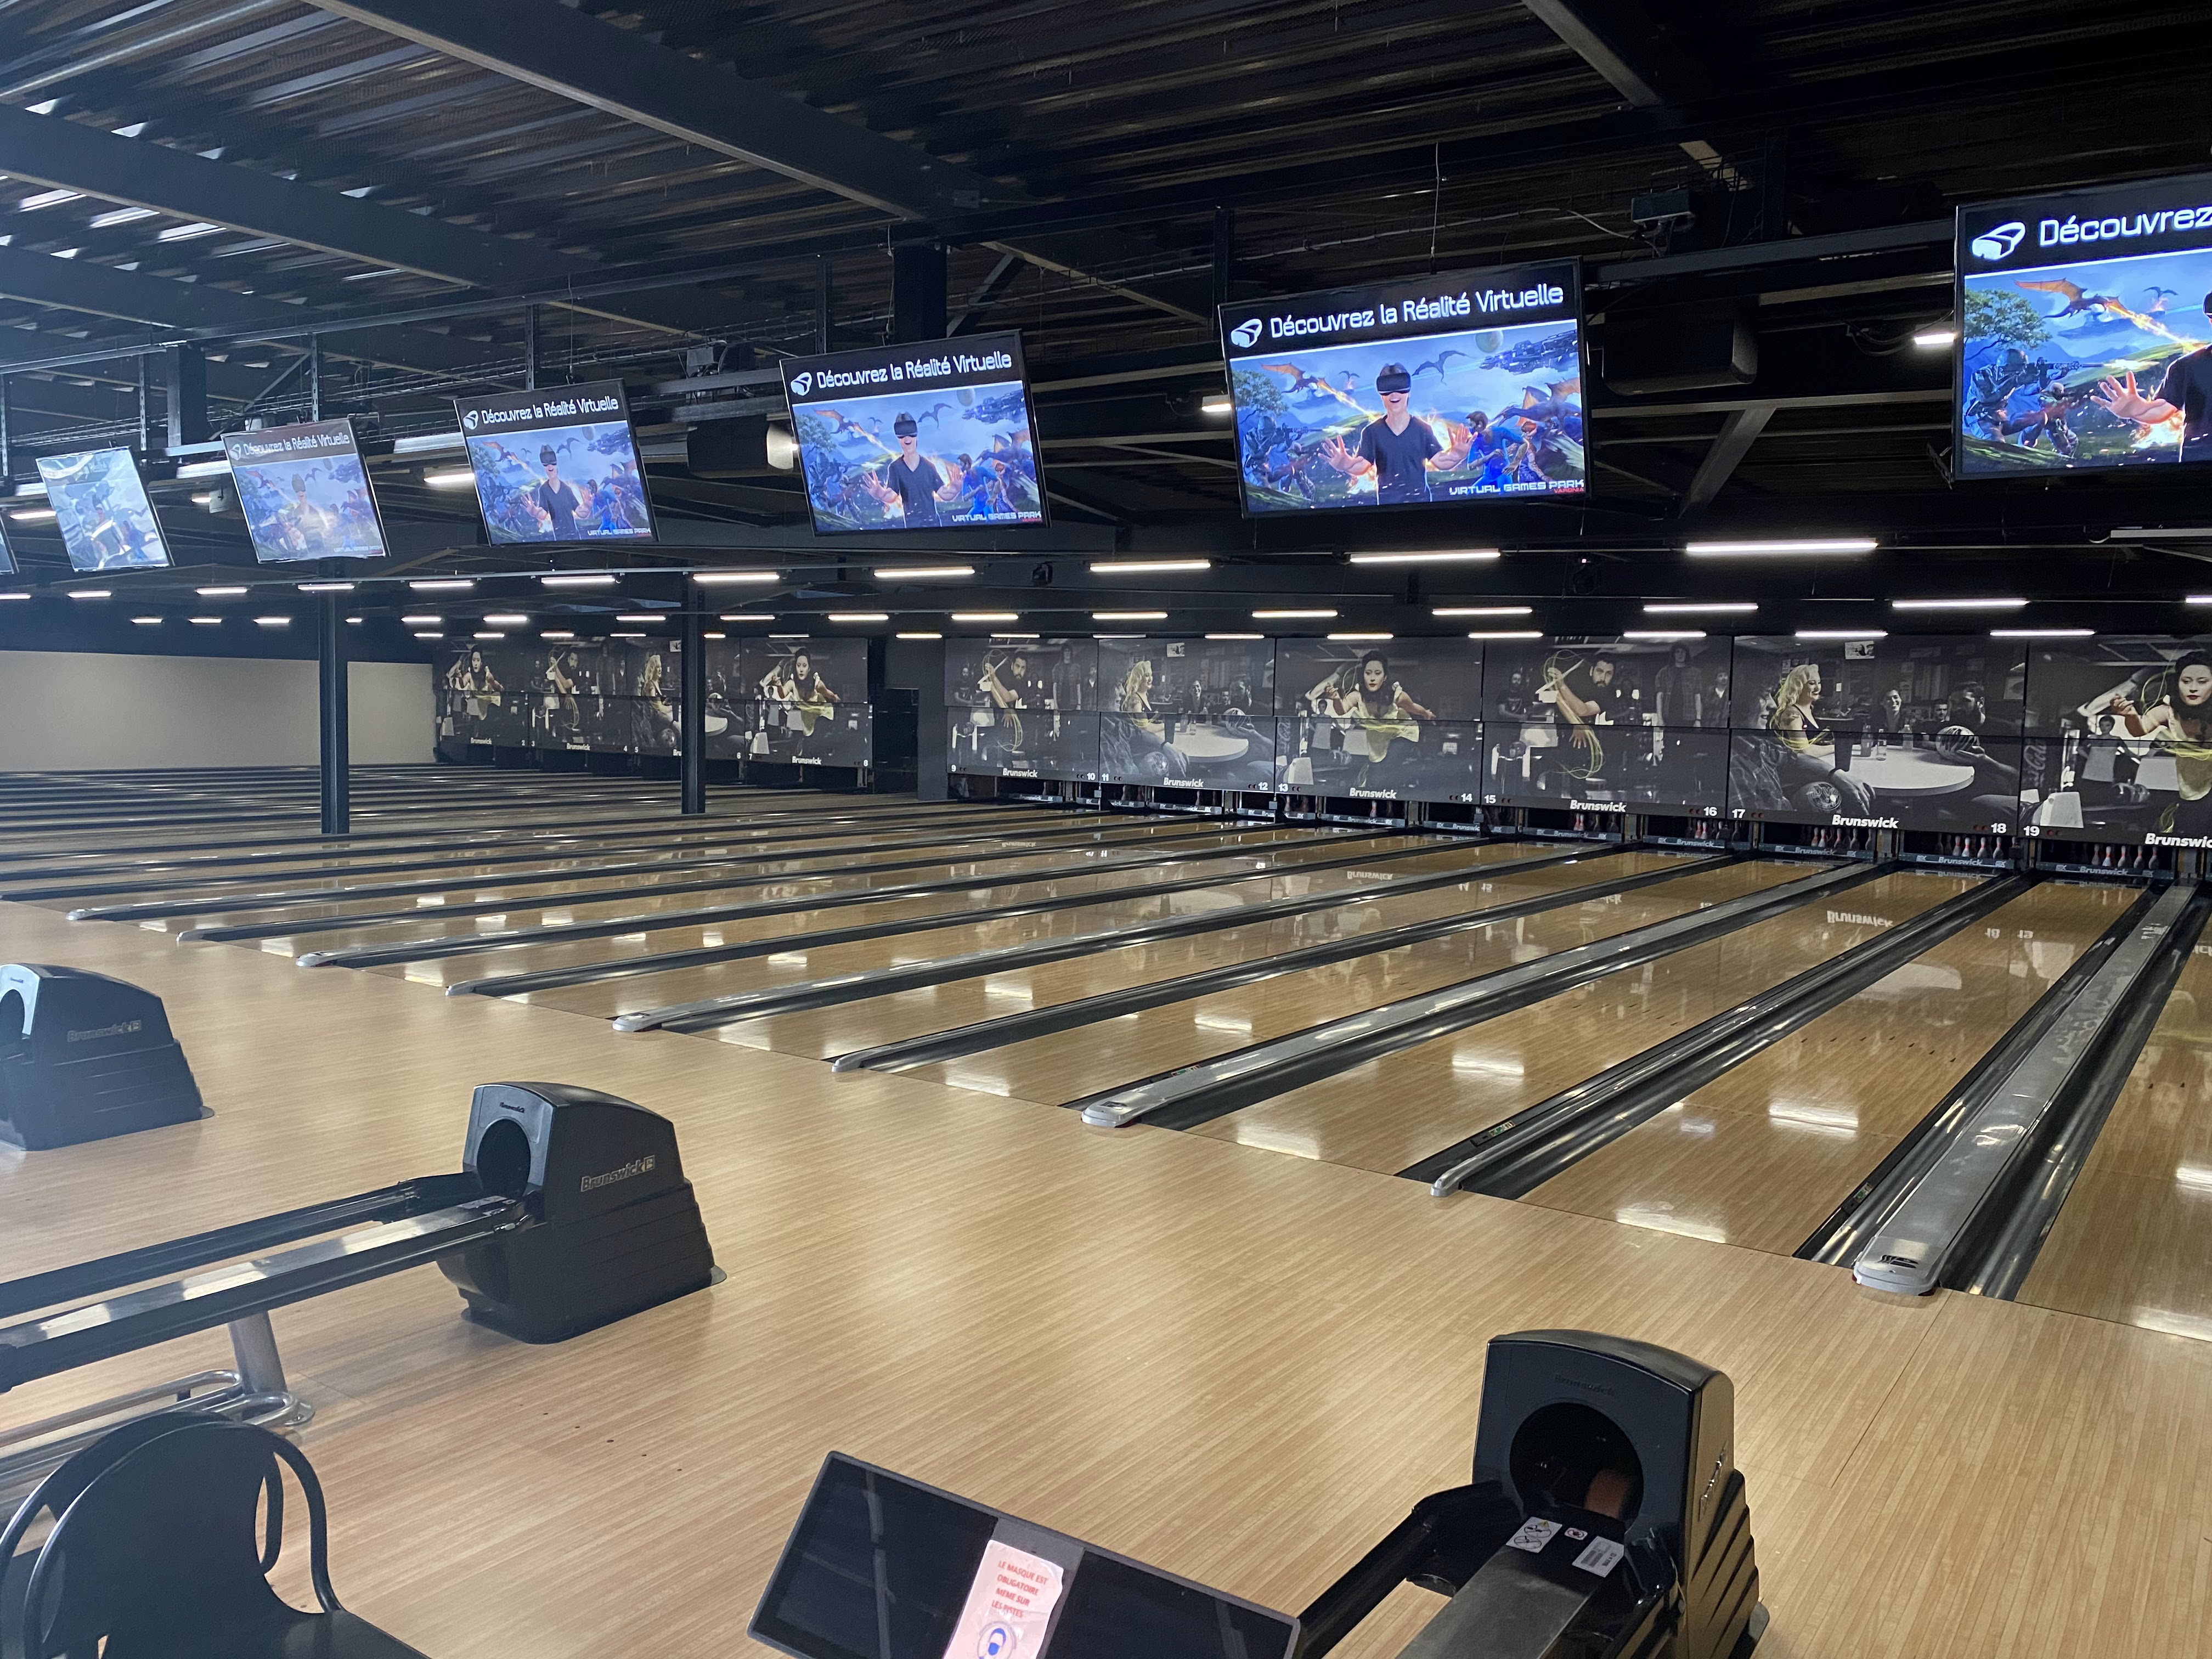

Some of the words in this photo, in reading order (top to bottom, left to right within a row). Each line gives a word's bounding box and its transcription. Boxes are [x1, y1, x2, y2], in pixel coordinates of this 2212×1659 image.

[2039, 205, 2212, 247] Découvrez
[1269, 309, 1374, 338] Découvrez
[1380, 303, 1398, 325] la
[1403, 292, 1470, 321] Réalité
[1475, 283, 1564, 314] Virtuelle
[816, 366, 887, 388] Découvrez
[890, 363, 903, 381] la
[905, 356, 951, 379] Réalité
[953, 350, 1012, 374] Virtuelle
[481, 407, 532, 425] Découvrez
[533, 404, 543, 419] la
[544, 398, 577, 417] Réalité
[576, 395, 619, 413] Virtuelle
[317, 432, 350, 449] Virtuelle
[1449, 484, 1500, 495] VIRTUAL
[1503, 481, 1547, 492] GAMES
[1549, 479, 1584, 489] PARK
[952, 514, 987, 522] VIRTUAL
[1018, 511, 1042, 519] PARK
[792, 755, 822, 765] Brunswick
[1002, 768, 1039, 778] Brunswick
[1086, 772, 1096, 781] 10
[1164, 777, 1204, 788] Brunswick
[1258, 782, 1268, 791] 12
[1278, 783, 1289, 792] 13
[1349, 787, 1397, 799] Brunswick
[1460, 793, 1473, 802] 14
[1484, 794, 1497, 804] 15
[1570, 799, 1627, 812] Brunswick
[1703, 806, 1717, 816] 16
[1731, 809, 1746, 819] 17
[1831, 814, 1899, 830] Brunswick
[1991, 822, 2007, 834] 18
[2023, 825, 2040, 837] 19
[1677, 838, 1714, 847] Brunswick
[2145, 832, 2212, 849] Brunswic
[1795, 847, 1835, 855] Brunswick
[1938, 856, 1983, 866] Brunswick
[2080, 866, 2128, 876] Brunswick
[581, 1159, 646, 1192] Brunswick
[997, 1560, 1006, 1568] LE
[1007, 1563, 1035, 1580] MASQUE
[1035, 1575, 1048, 1585] EST
[997, 1574, 1039, 1596] OBLIGATOIRE
[1016, 1595, 1030, 1607] SUR
[991, 1600, 1002, 1610] LES
[1003, 1605, 1024, 1618] PISTES
